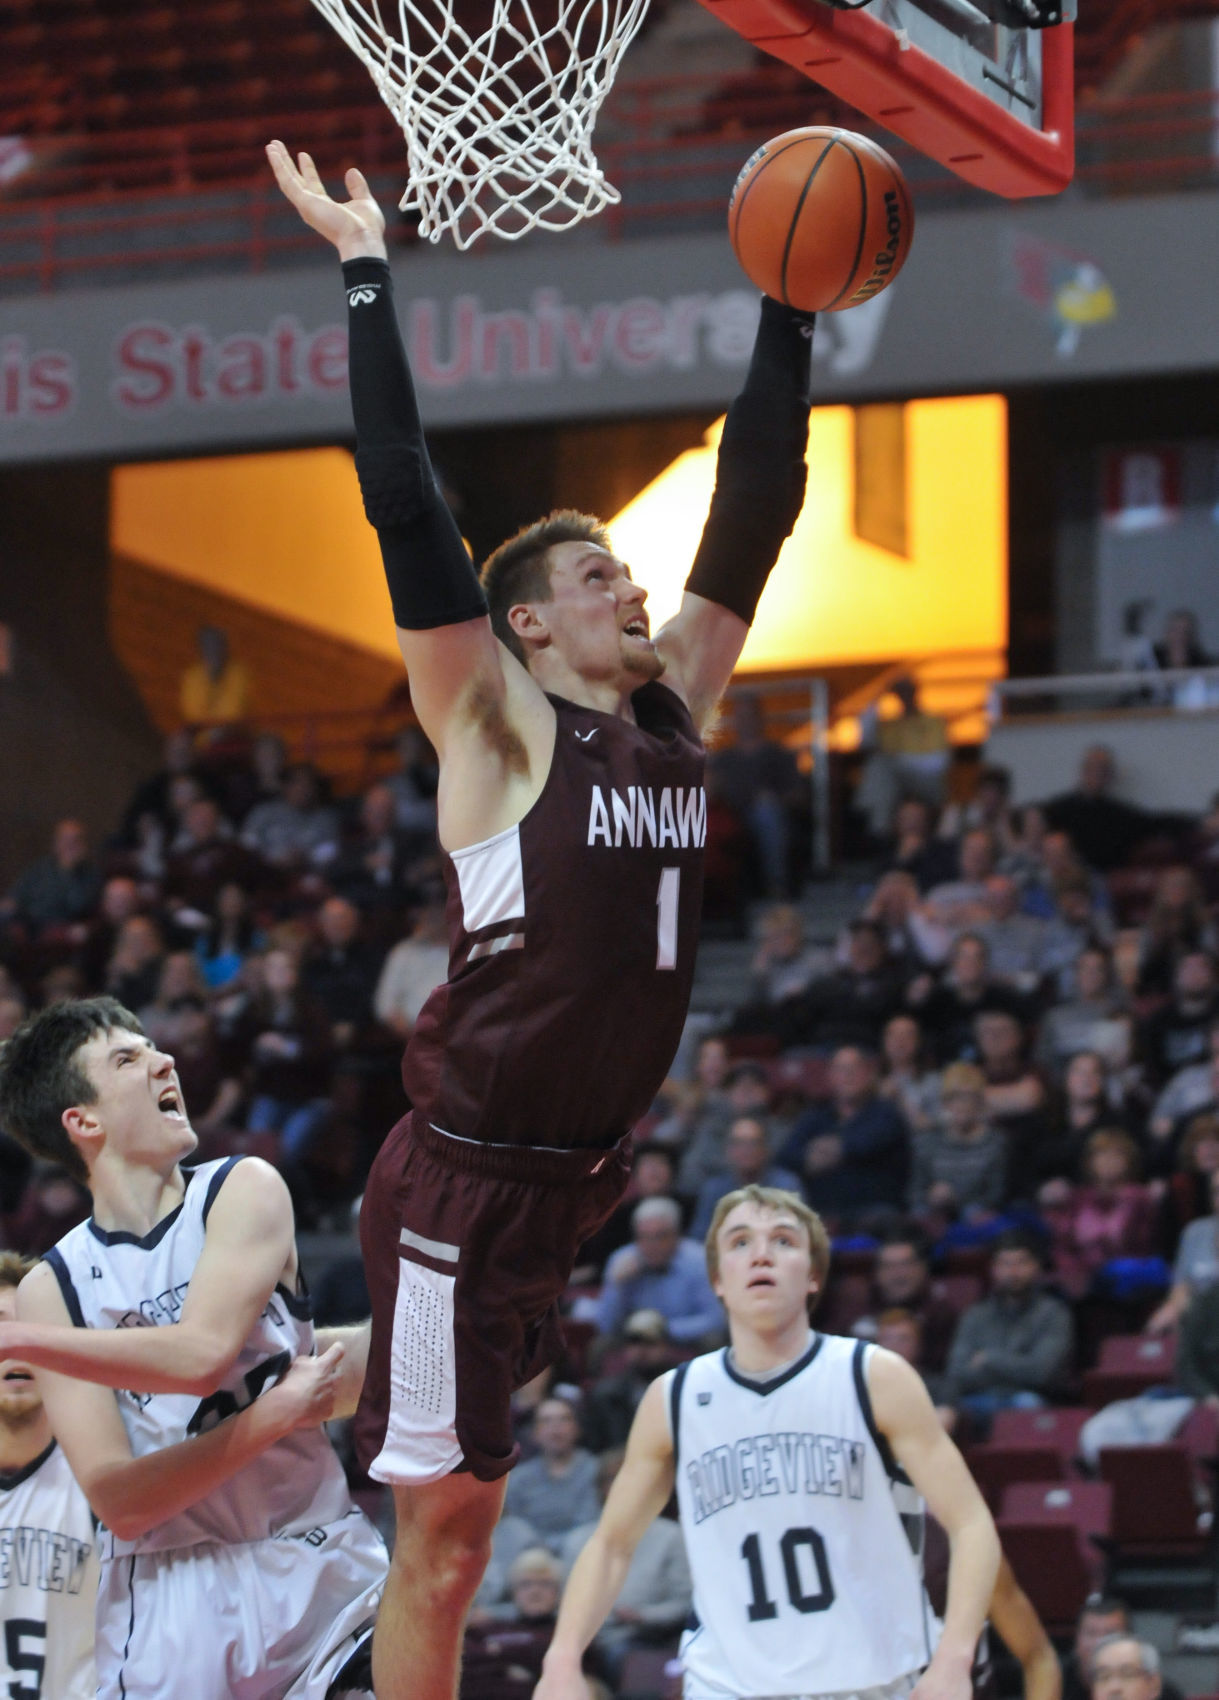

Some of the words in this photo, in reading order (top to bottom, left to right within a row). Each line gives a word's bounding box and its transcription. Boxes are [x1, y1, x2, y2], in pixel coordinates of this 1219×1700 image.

[849, 190, 900, 303] Wilson
[115, 316, 350, 411] State
[656, 866, 681, 971] 1
[741, 1527, 836, 1623] 10
